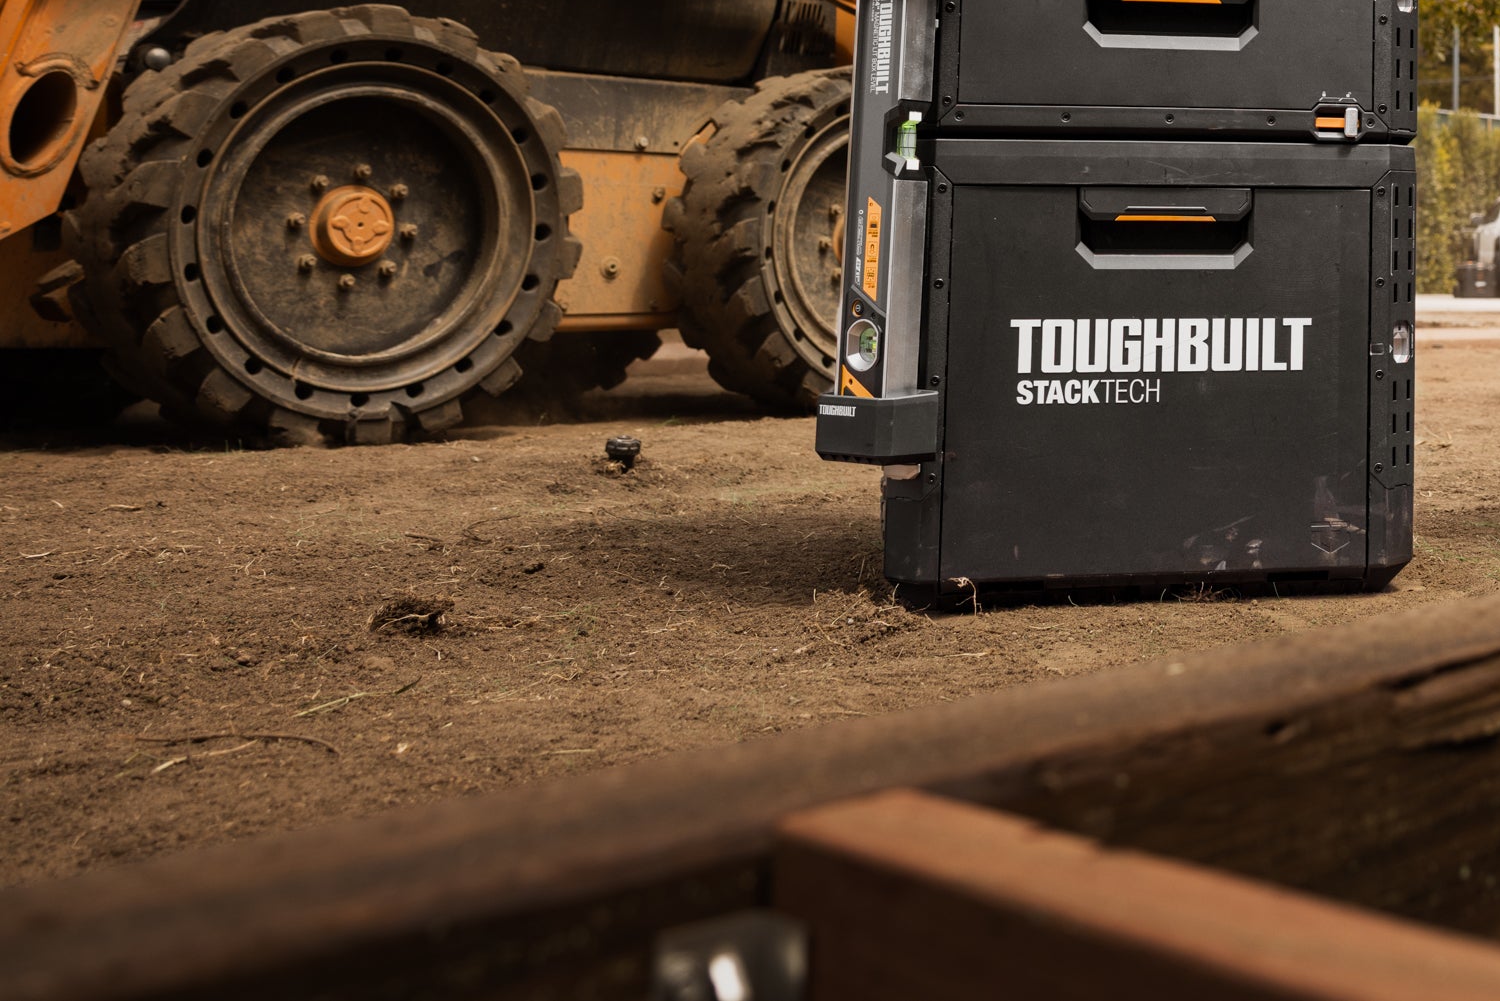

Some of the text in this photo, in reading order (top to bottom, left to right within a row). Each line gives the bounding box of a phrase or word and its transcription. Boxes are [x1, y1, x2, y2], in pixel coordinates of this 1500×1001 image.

[872, 11, 880, 46] MAGNETIC
[869, 73, 877, 93] LEVEL
[1010, 317, 1313, 374] TOUGHBUILT
[1016, 379, 1161, 405] STACKTECH
[819, 404, 856, 417] TOUGHBUILT
